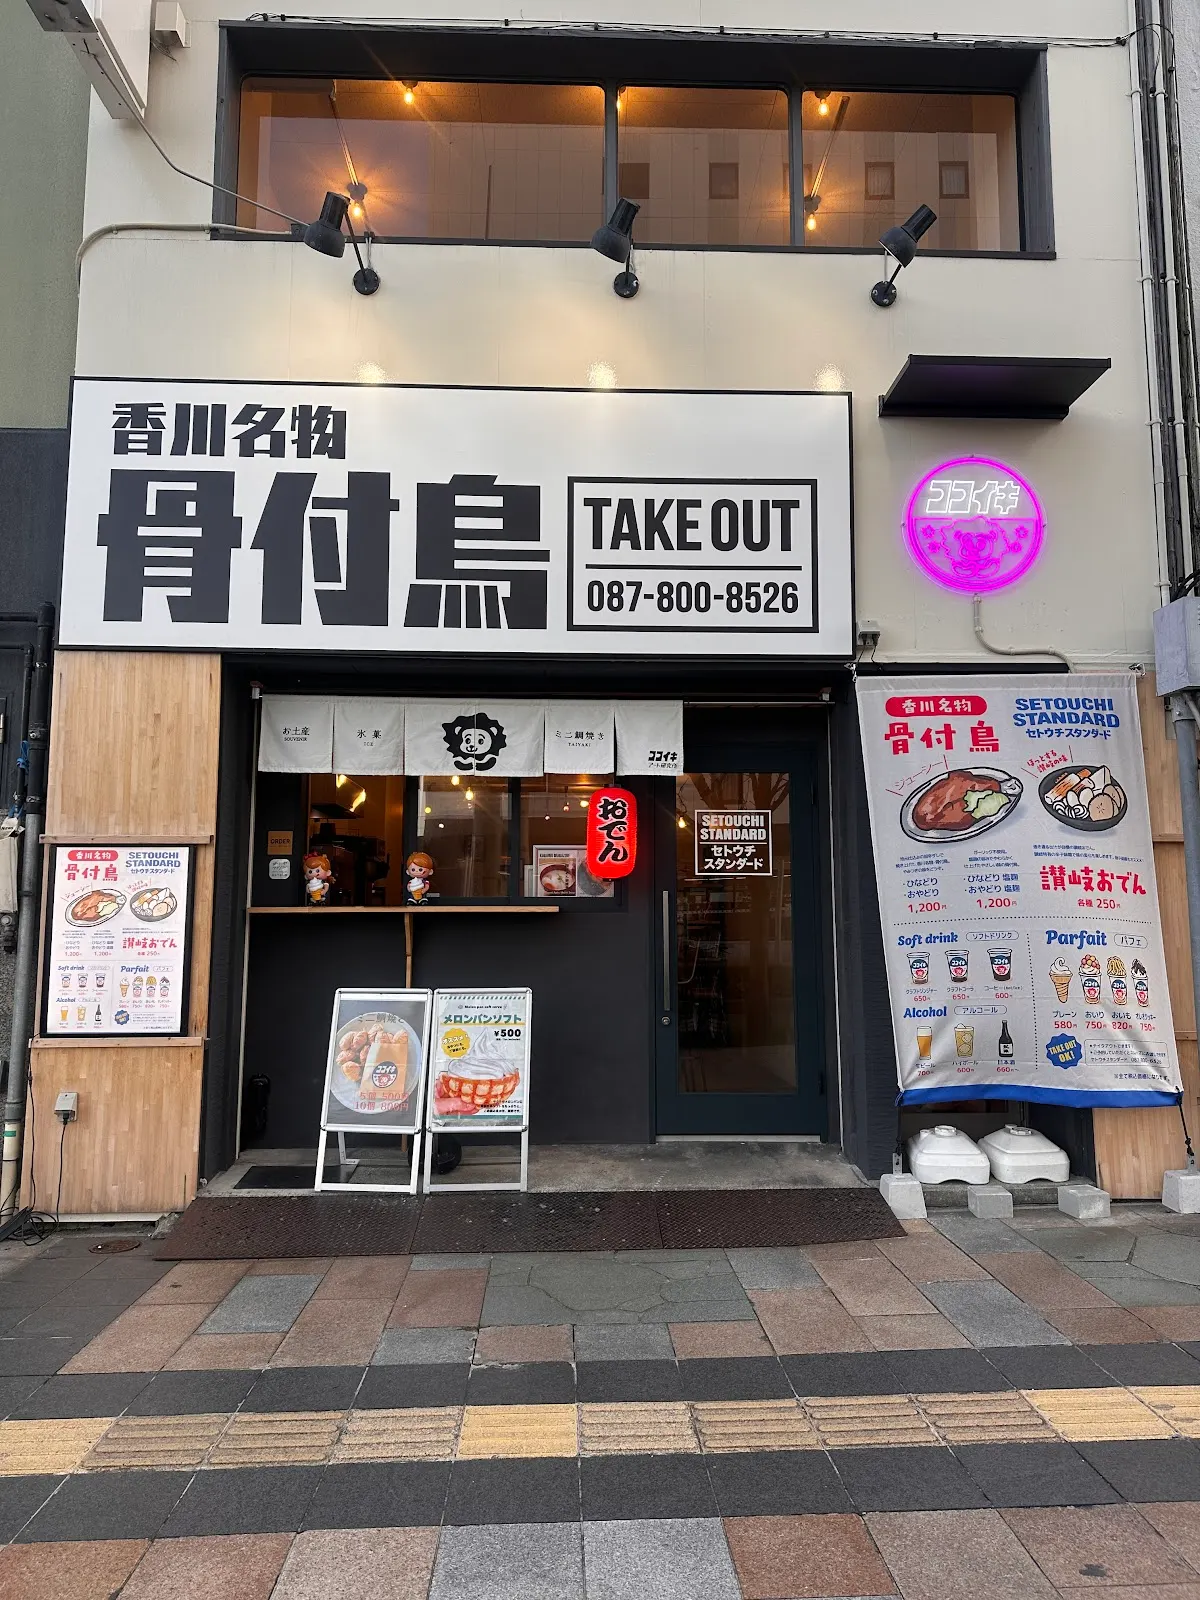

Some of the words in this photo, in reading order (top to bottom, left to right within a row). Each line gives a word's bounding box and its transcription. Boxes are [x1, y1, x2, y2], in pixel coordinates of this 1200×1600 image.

[112, 402, 347, 459] 香川名物
[925, 480, 1021, 515] ココイキ
[584, 498, 702, 551] TAKE
[711, 499, 800, 553] OUT
[96, 469, 551, 630] 骨付鳥
[587, 580, 799, 614] 087-800-8526
[902, 699, 972, 714] 香川名物
[1015, 698, 1114, 711] SETOUCHI
[1012, 712, 1120, 728] STANDARD
[283, 726, 310, 736] お土産
[357, 729, 382, 739] 氷菓
[555, 730, 605, 740] ミニ鯛焼き
[1026, 727, 1111, 741] セトウチスタンダード
[884, 720, 1000, 756] 骨付鳥
[648, 750, 678, 762] ココイキ
[1026, 749, 1058, 767] ほっとする
[894, 761, 944, 791] ジューシー
[701, 815, 765, 827] SETOUCHI
[598, 797, 628, 863] おでん
[700, 828, 767, 841] STANDARD
[75, 852, 112, 860] 香川名物
[128, 851, 179, 860] SETOUCHI
[711, 844, 756, 857] セトウチ
[125, 860, 181, 868] STANDARD
[704, 857, 764, 870] スタンダード
[65, 863, 118, 881] 骨付鳥
[906, 877, 938, 887] ひなどり
[967, 875, 1001, 883] ひなどり
[1039, 864, 1147, 895] 讃岐おでん
[907, 888, 939, 899] おやどり
[968, 885, 1002, 894] おやどり
[976, 898, 1018, 910] 1,200円
[897, 934, 923, 948] Soft
[925, 932, 958, 944] drink
[972, 931, 1013, 939] ソフトドリンク
[1045, 930, 1107, 950] Parfait
[122, 937, 178, 949] 讃岐おでん
[1121, 936, 1142, 947] パフェ
[120, 965, 149, 975] Parfait
[903, 1005, 948, 1019] Alcohol
[962, 1006, 999, 1014] アルコール
[1053, 1011, 1078, 1019] プレーン
[1085, 1011, 1105, 1019] おいり
[1111, 1011, 1132, 1020] おいも
[443, 1013, 522, 1024] メロンパンソフト
[494, 1028, 522, 1038] ¥500
[1048, 1044, 1064, 1055] TAKE
[1064, 1040, 1077, 1050] OUT
[1058, 1051, 1075, 1063] OK!
[376, 1065, 396, 1074] ココイキ
